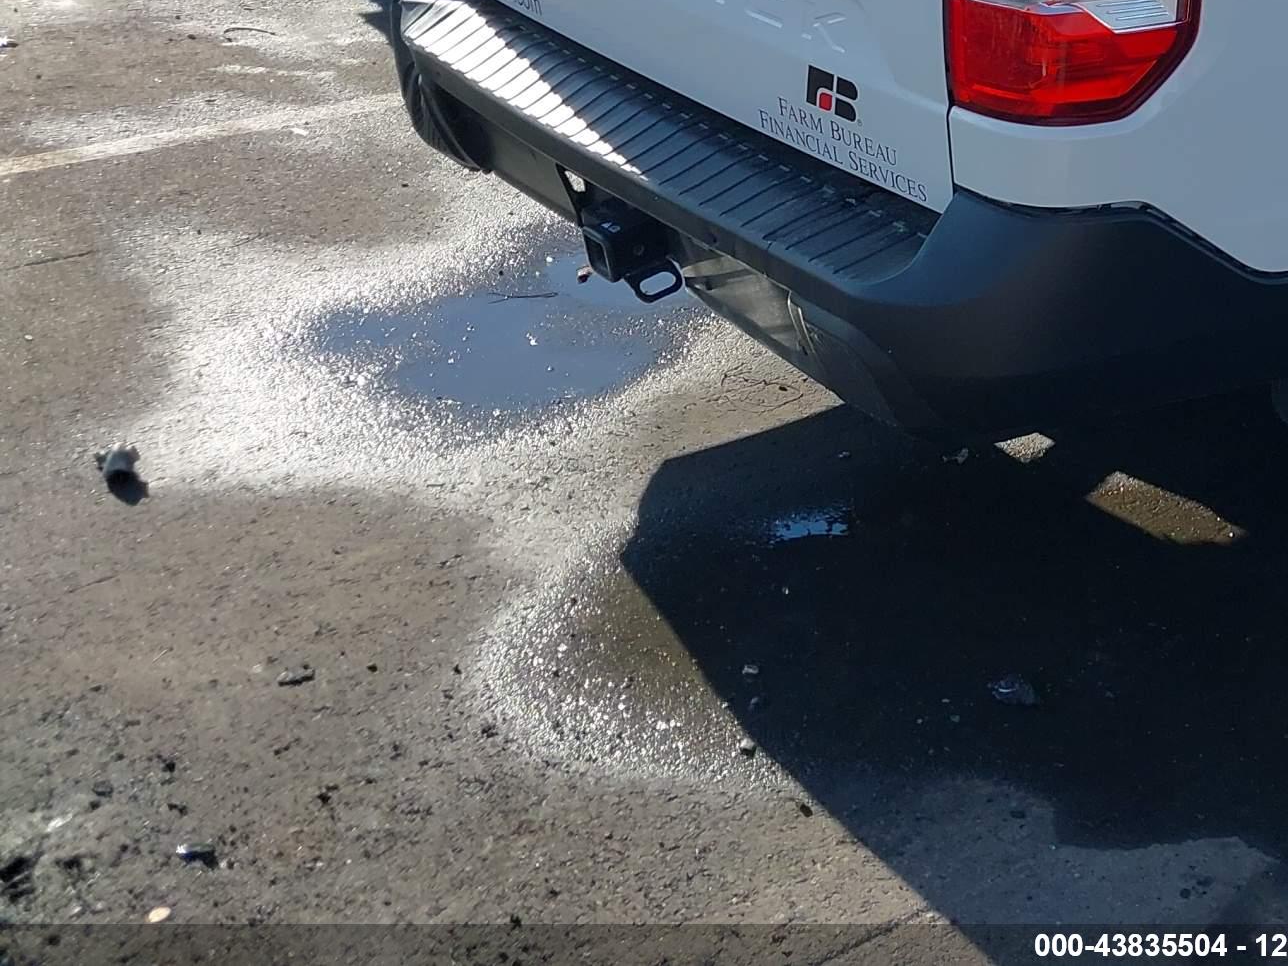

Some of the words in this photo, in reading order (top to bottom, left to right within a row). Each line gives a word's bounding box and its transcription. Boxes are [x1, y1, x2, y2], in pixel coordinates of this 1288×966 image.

[759, 109, 844, 165] FINANCIAL
[849, 150, 927, 202] SERVICES
[778, 96, 824, 133] FARM
[830, 120, 897, 166] BUREAU
